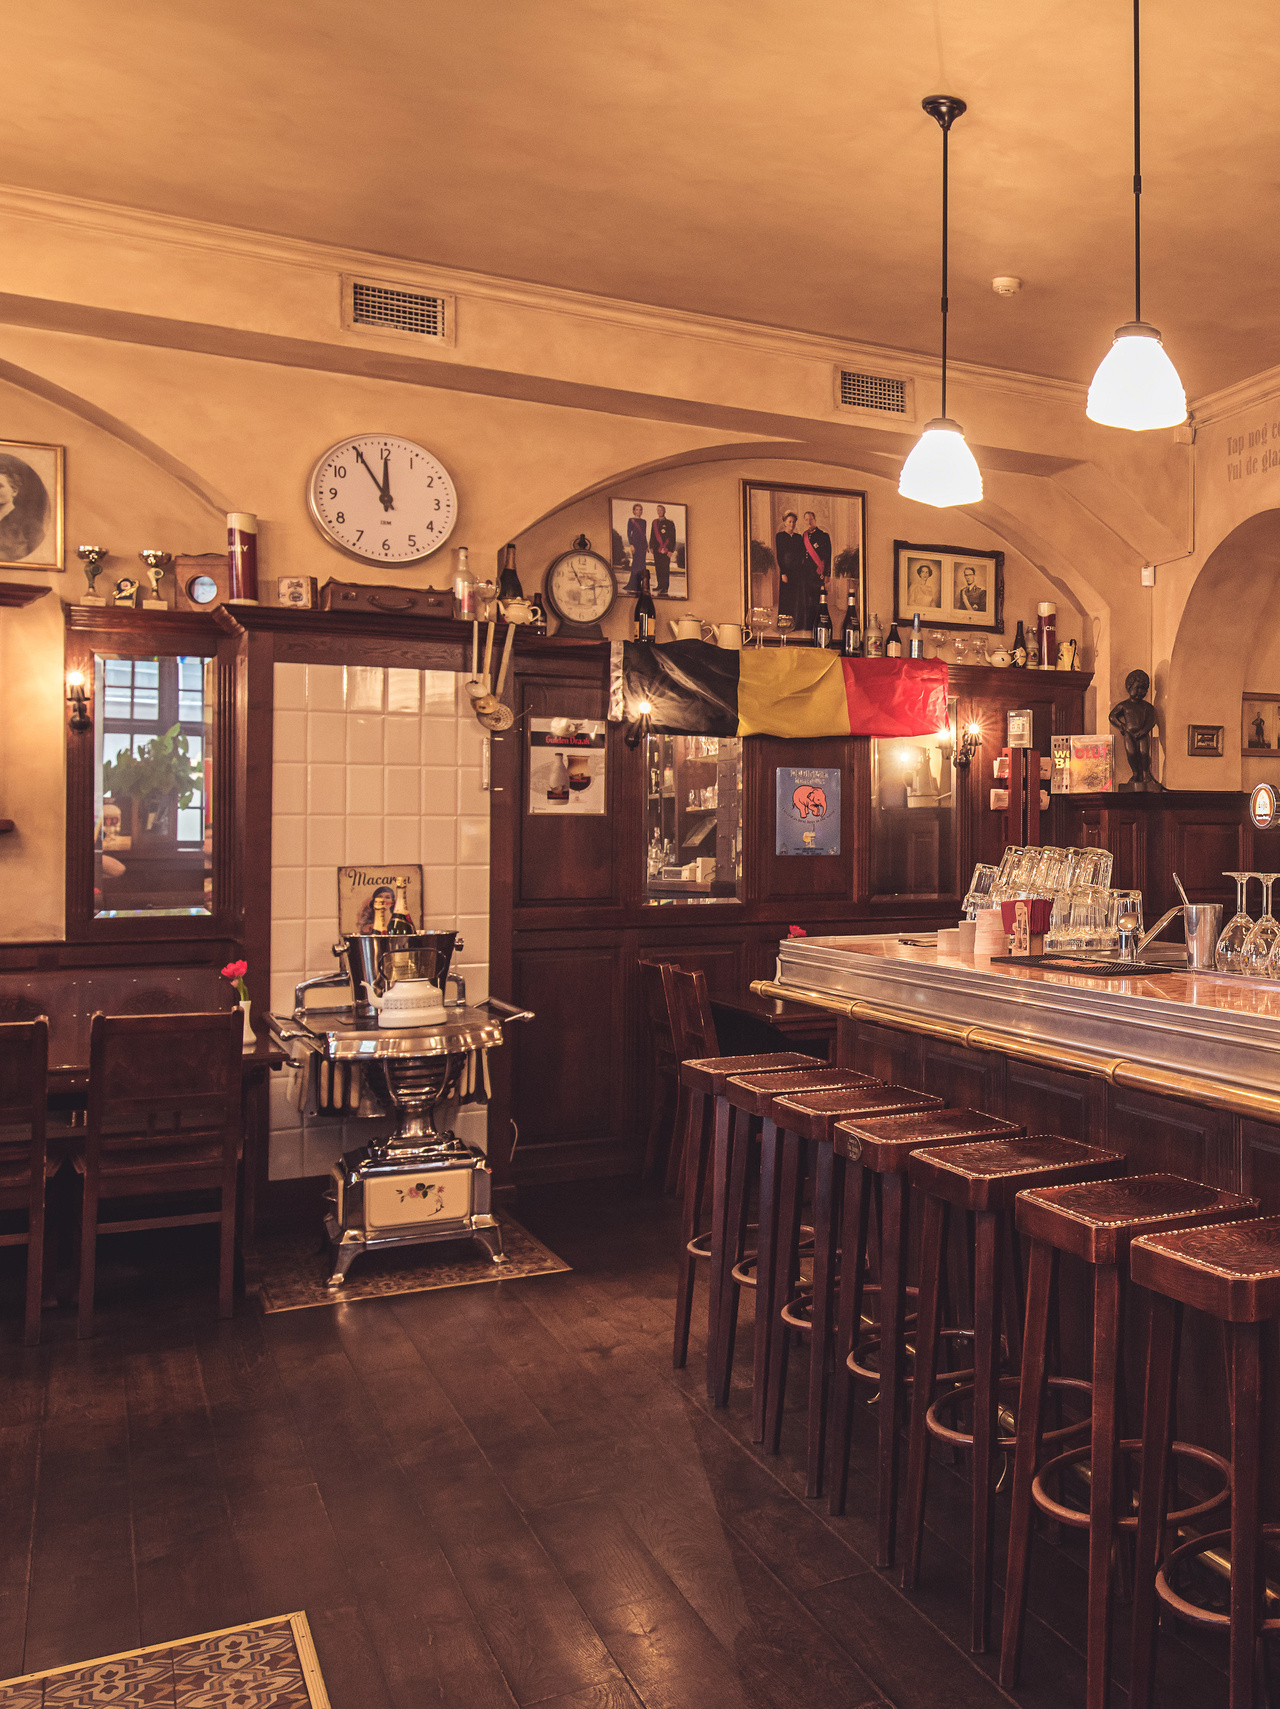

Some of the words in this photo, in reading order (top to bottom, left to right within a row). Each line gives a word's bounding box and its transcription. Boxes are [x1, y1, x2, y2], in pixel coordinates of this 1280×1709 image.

[1227, 435, 1245, 455] Tap
[1248, 423, 1268, 446] nog
[380, 447, 391, 461] 12
[409, 457, 413, 470] 1
[1227, 460, 1242, 482] Vul
[1246, 456, 1258, 475] de
[334, 465, 347, 479] 10
[426, 475, 434, 488] 2
[329, 487, 338, 500] 9
[433, 498, 441, 511] 3
[336, 511, 345, 524] 8
[426, 520, 434, 532] 4
[355, 529, 365, 542] 7
[408, 534, 417, 547] 5
[381, 538, 391, 551] 6
[1074, 747, 1108, 760] OLUT
